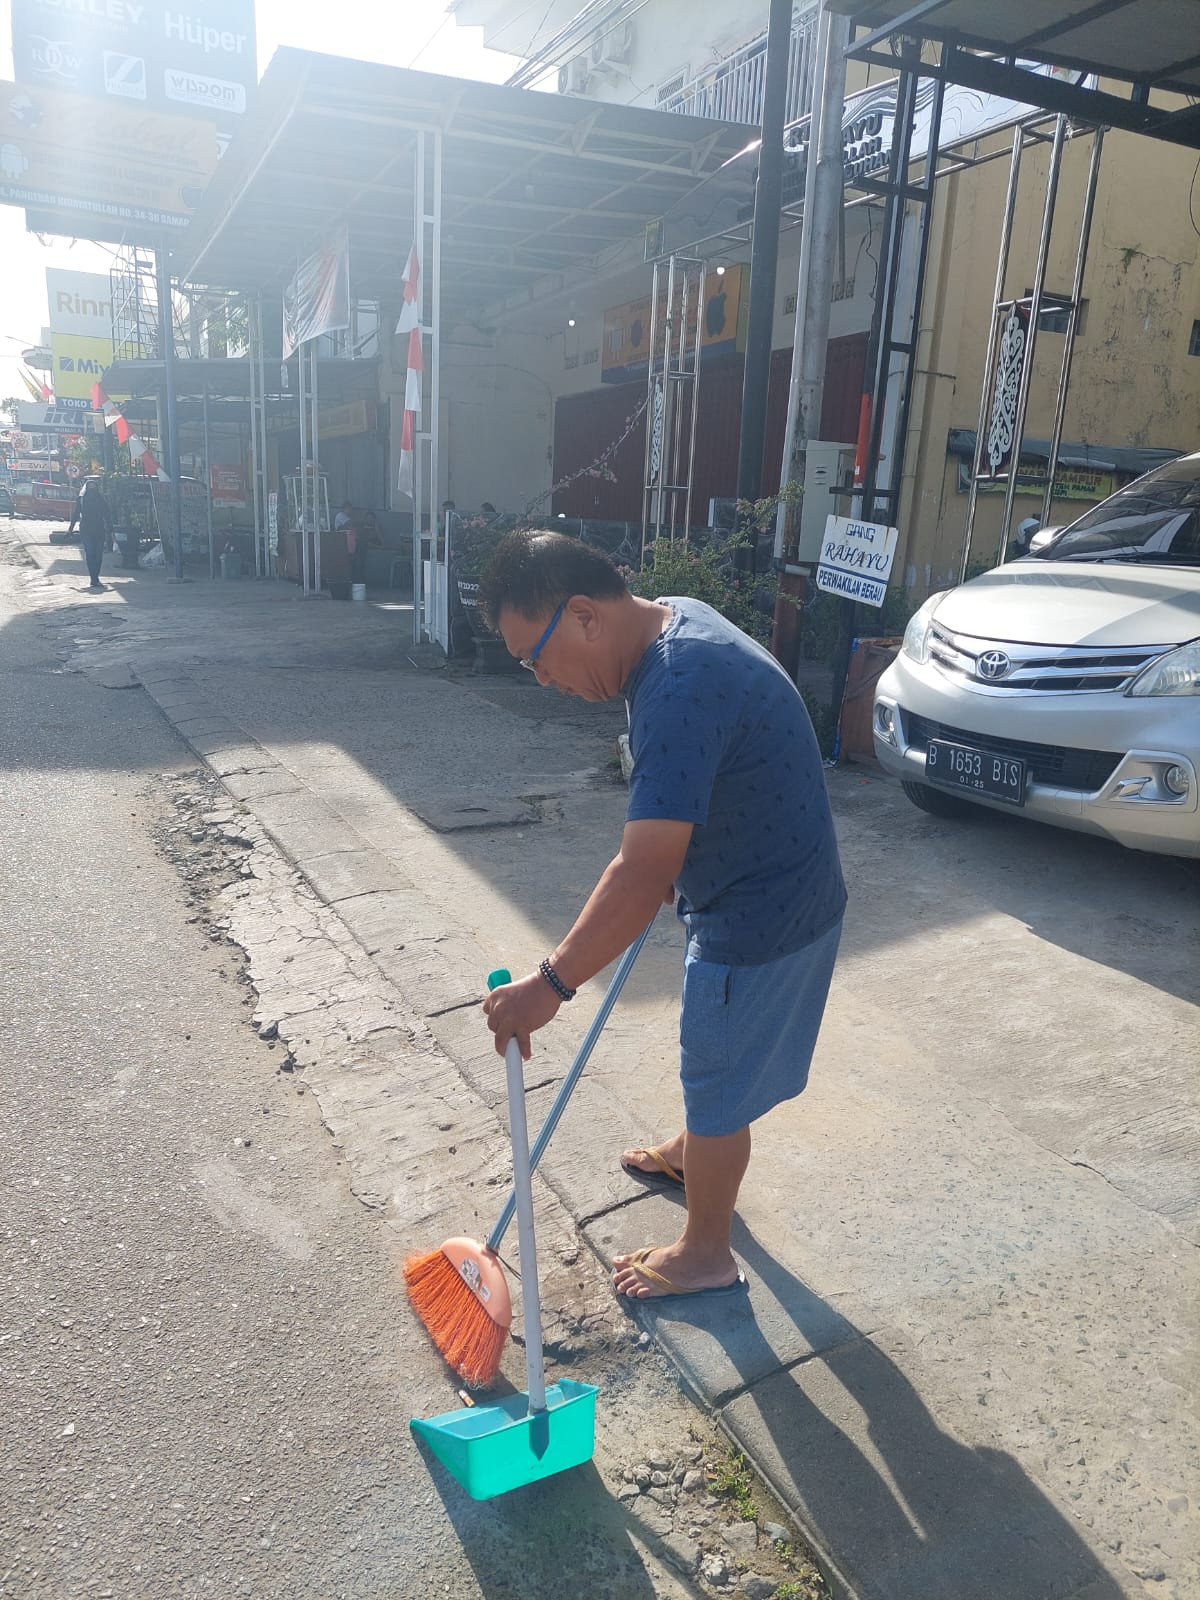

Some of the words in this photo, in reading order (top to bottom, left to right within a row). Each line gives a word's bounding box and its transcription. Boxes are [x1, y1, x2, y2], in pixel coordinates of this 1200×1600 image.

[164, 10, 248, 54] Hüper
[62, 398, 87, 408] TOKO
[846, 523, 876, 543] GANG
[824, 542, 889, 571] RAHAYU
[860, 582, 884, 602] BERAU
[928, 745, 938, 766] B
[949, 750, 982, 776] 1653
[992, 760, 1018, 786] BIS
